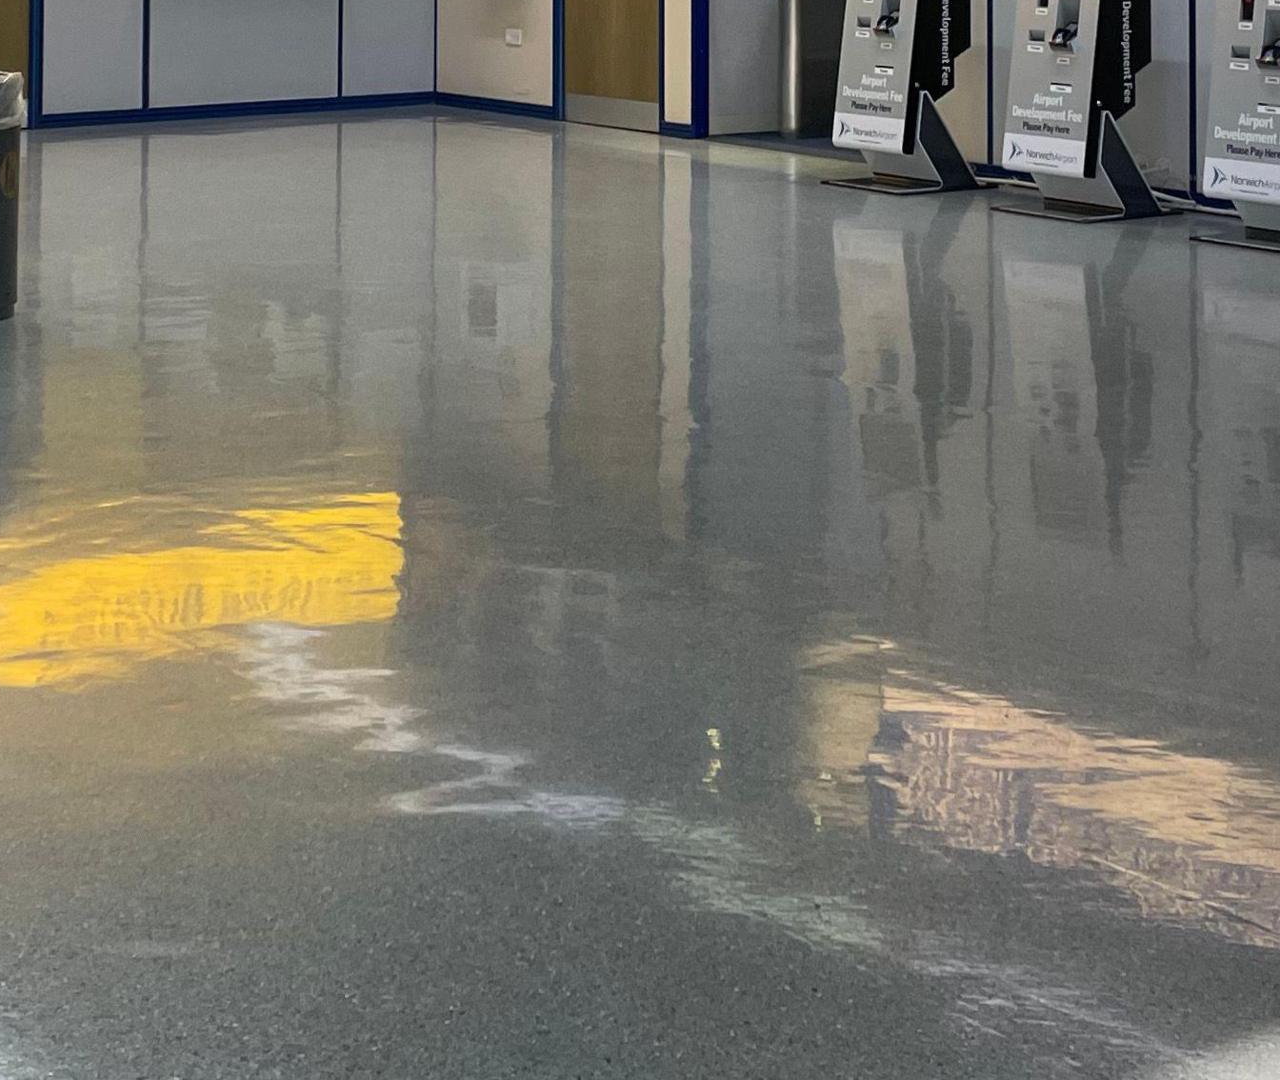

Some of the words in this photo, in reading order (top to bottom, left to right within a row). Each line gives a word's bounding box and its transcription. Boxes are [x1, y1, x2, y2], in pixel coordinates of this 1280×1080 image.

[1120, 1, 1132, 80] Development
[861, 74, 887, 88] Airport
[941, 65, 951, 86] Fee
[842, 86, 889, 101] Development
[890, 91, 903, 103] Fee
[1033, 93, 1063, 107] Airport
[1123, 82, 1133, 104] Fee
[851, 100, 868, 111] Please
[869, 102, 879, 114] Pay
[879, 103, 892, 114] Here
[1012, 105, 1066, 122] Development
[1068, 110, 1083, 123] Fee
[1022, 122, 1042, 133] Please
[1042, 123, 1055, 136] Pay
[1238, 113, 1274, 131] Airport
[1214, 126, 1278, 145] Development
[1025, 149, 1078, 164] NorwichAirport
[1226, 144, 1249, 157] Please
[1250, 146, 1263, 159] Pay
